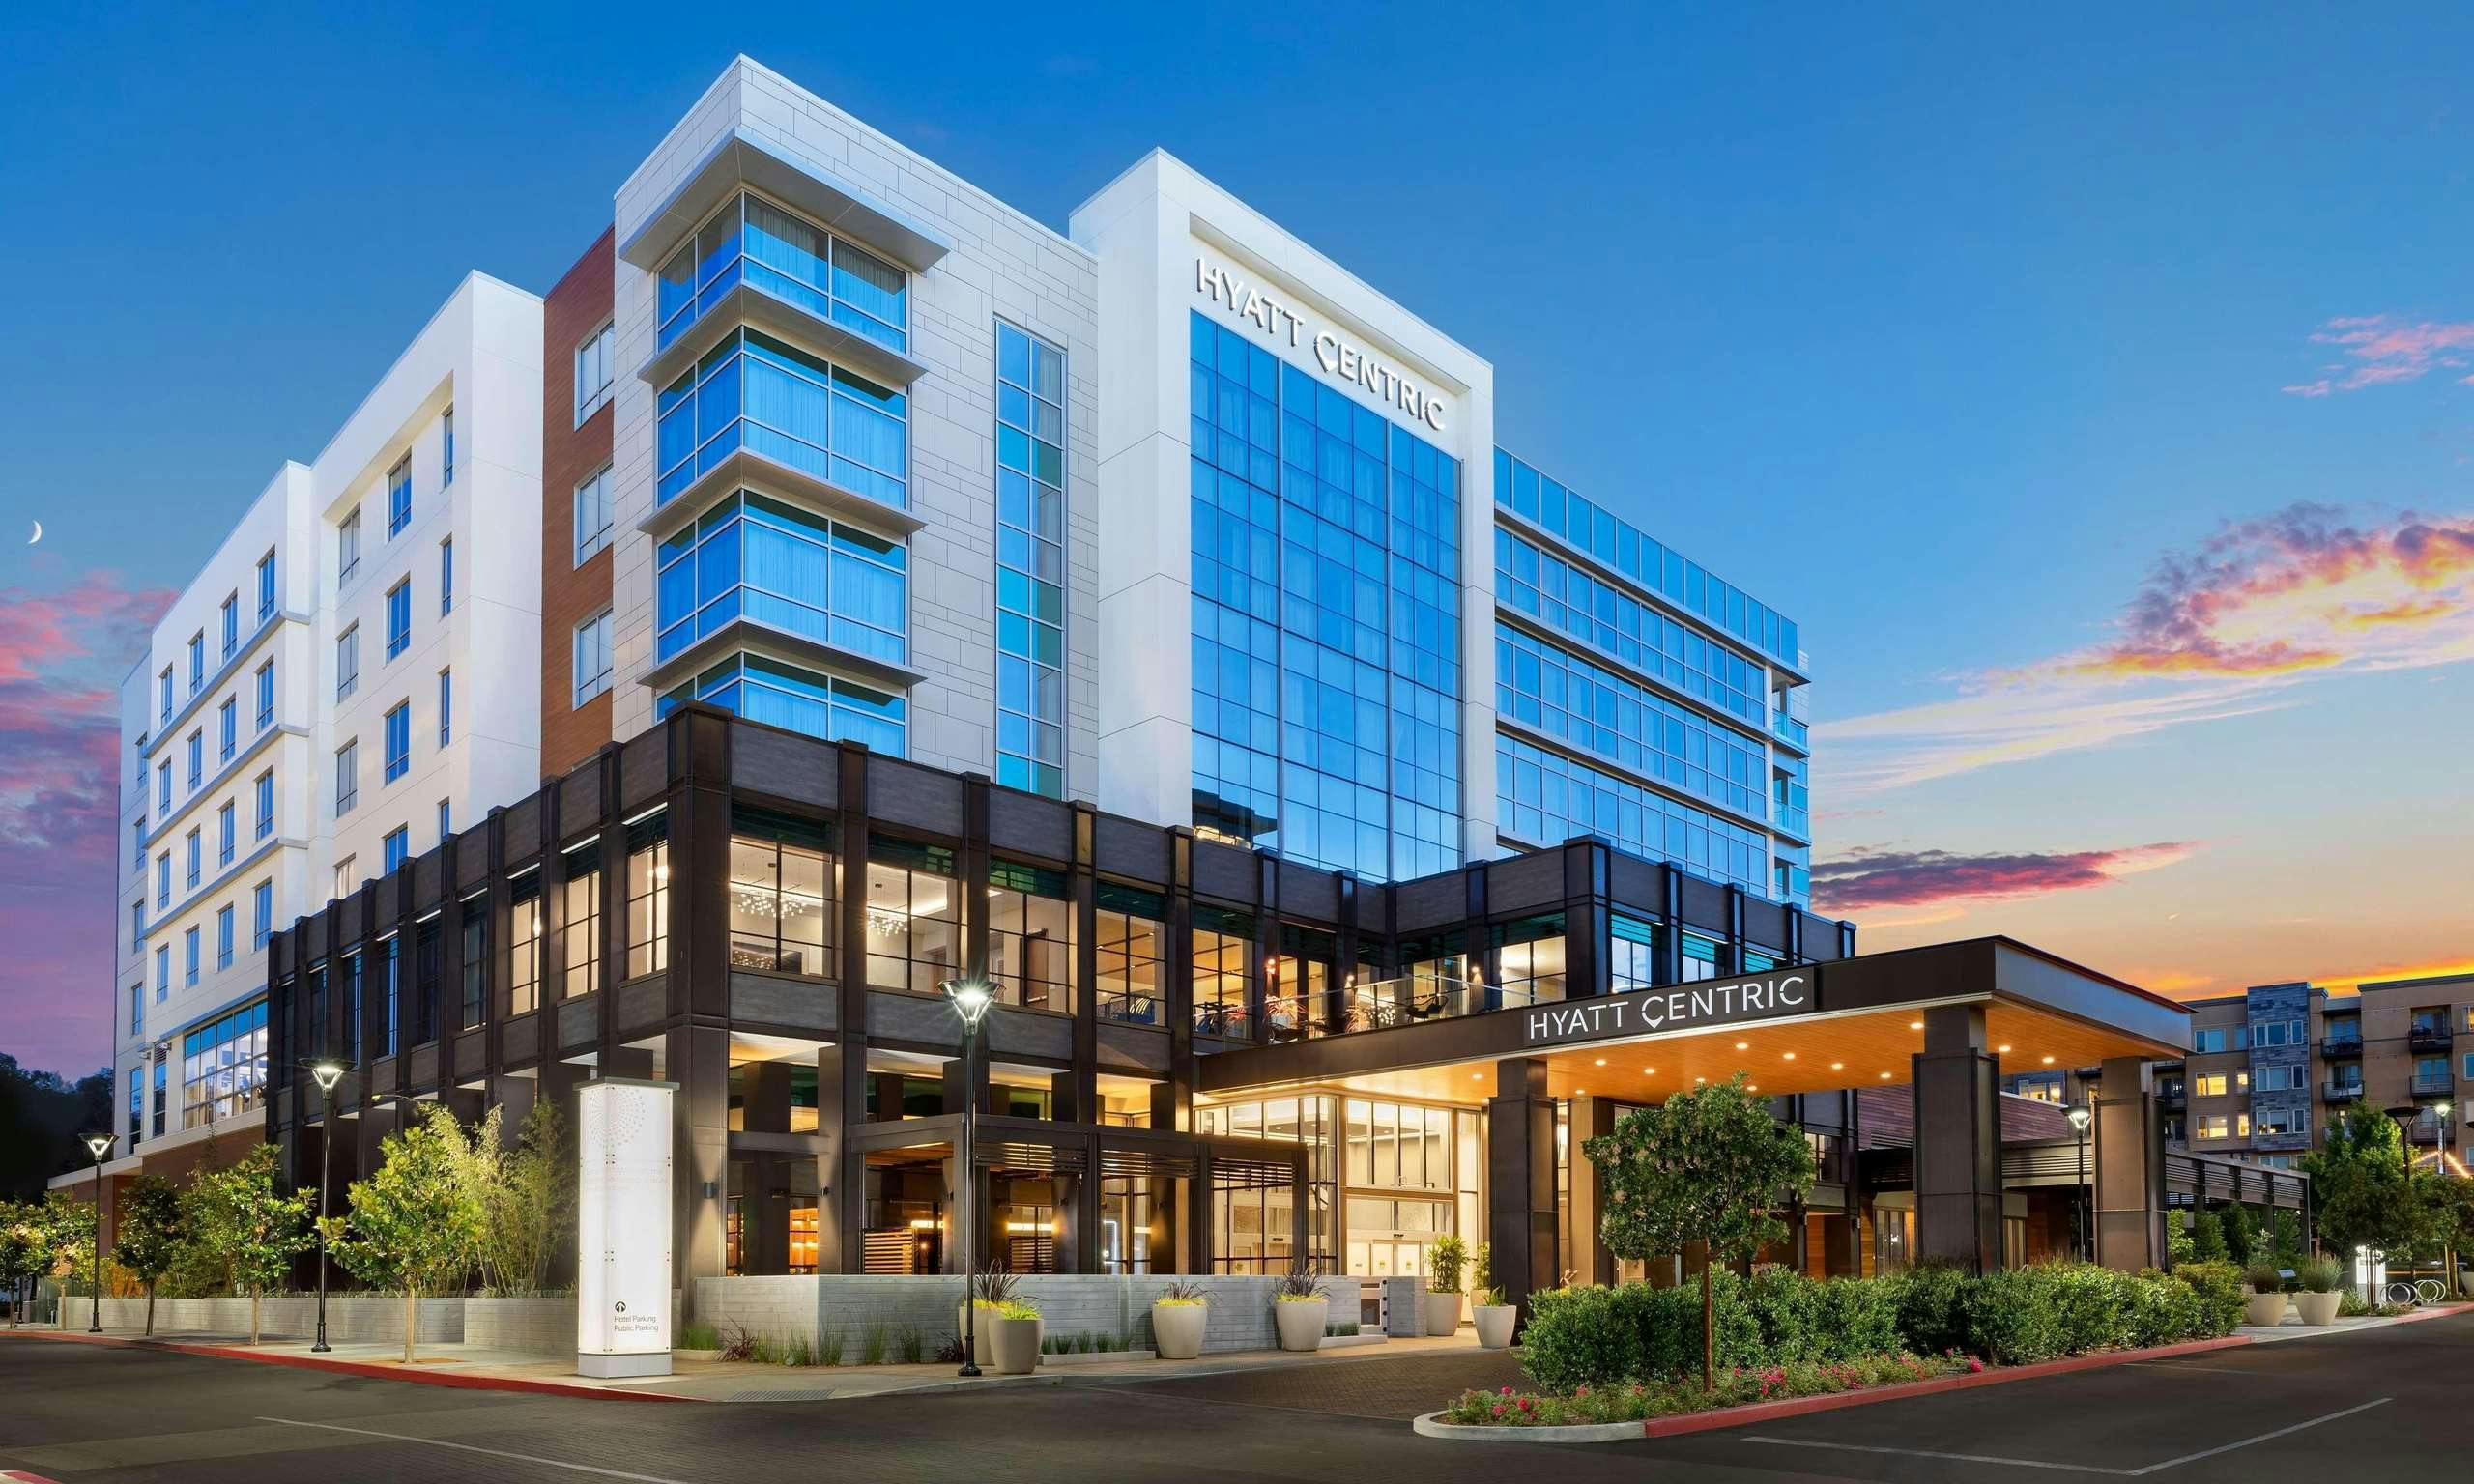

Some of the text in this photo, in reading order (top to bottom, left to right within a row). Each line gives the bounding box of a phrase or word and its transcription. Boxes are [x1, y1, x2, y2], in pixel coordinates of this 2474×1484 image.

[1196, 258, 1446, 431] HYATT CENTRIC
[1530, 976, 1804, 1040] HYATT CENTRIC
